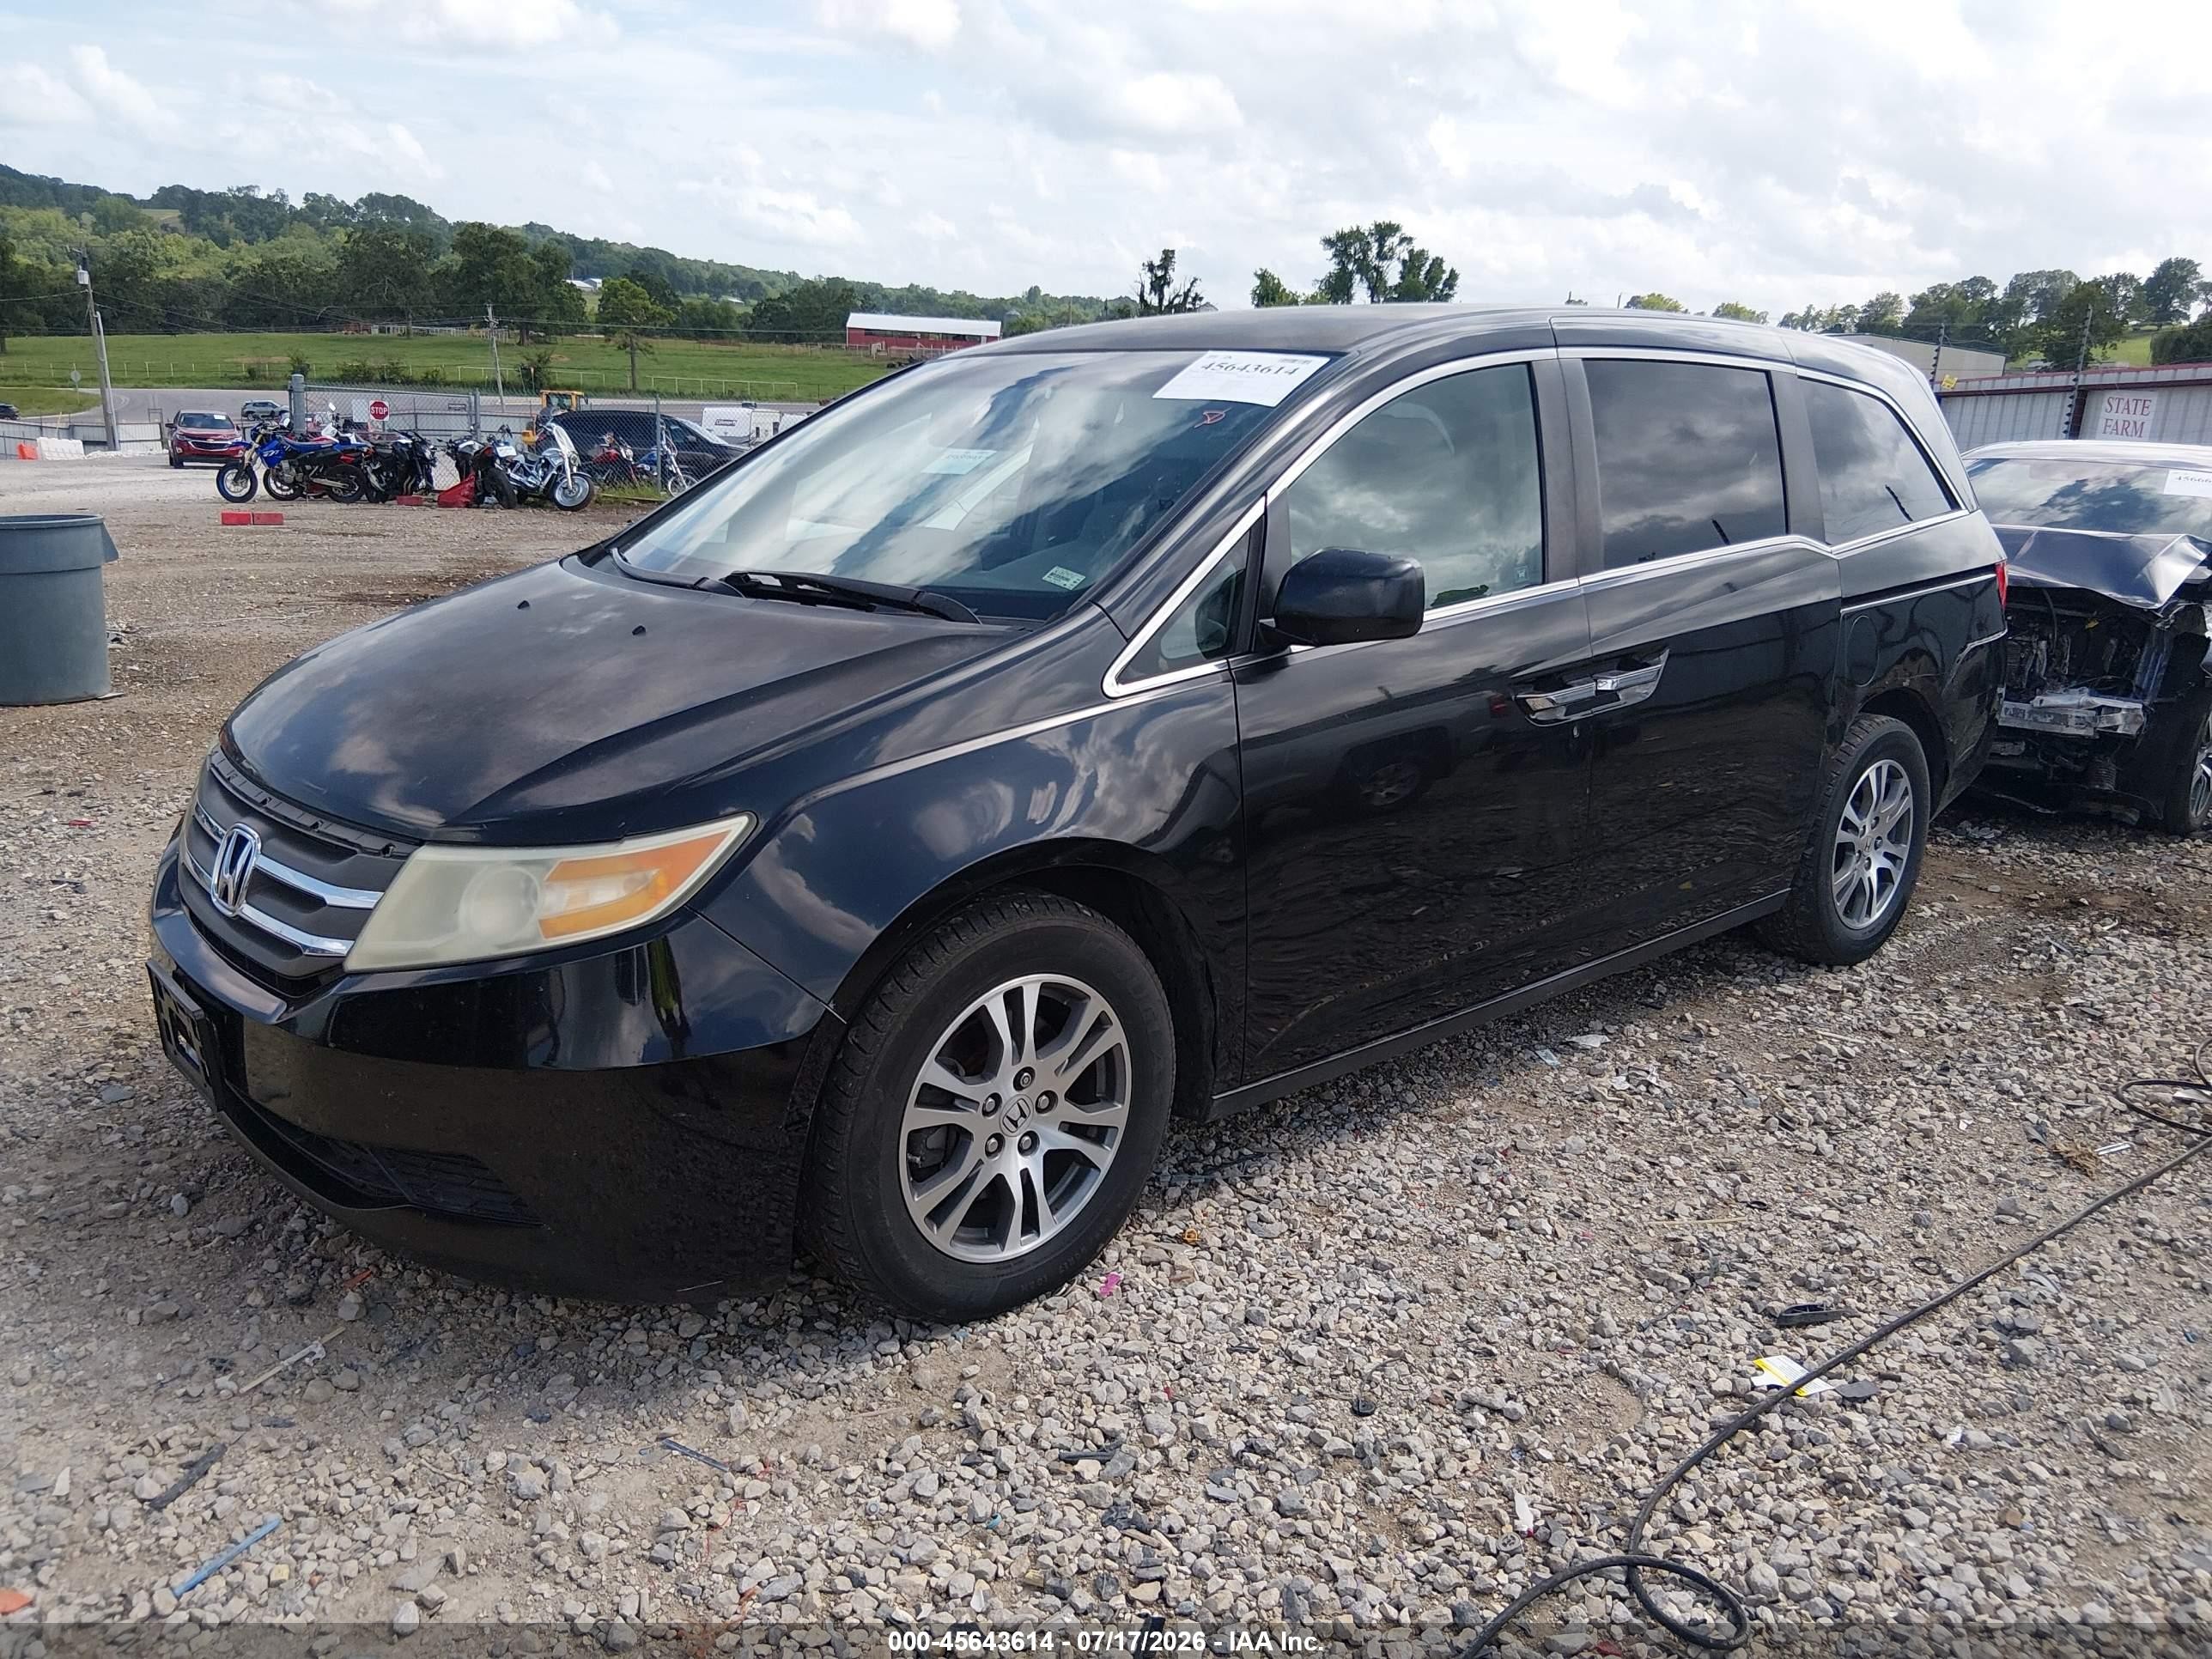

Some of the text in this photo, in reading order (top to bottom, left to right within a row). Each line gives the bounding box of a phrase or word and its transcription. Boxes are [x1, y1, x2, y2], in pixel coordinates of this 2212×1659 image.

[1201, 362, 1299, 374] 45643614
[2105, 397, 2152, 416] STATE
[2102, 418, 2145, 438] FARM
